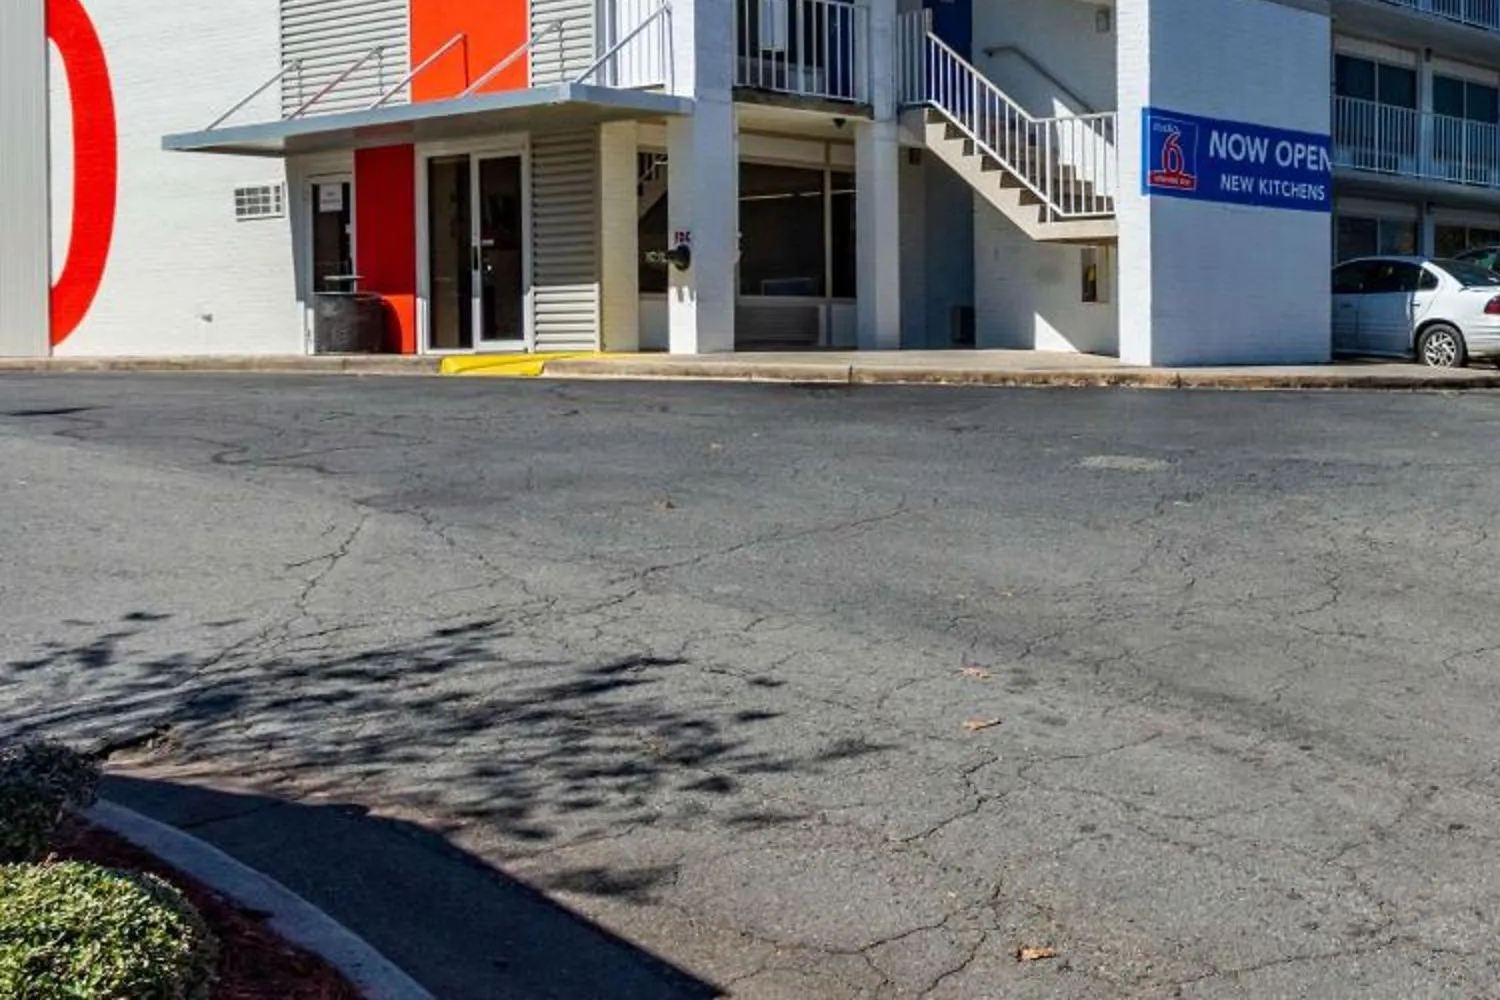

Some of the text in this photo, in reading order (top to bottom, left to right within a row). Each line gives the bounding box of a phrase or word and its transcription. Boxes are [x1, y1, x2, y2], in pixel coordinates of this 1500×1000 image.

[1209, 130, 1270, 165] NOW
[1220, 173, 1326, 201] NEW KITCHENS
